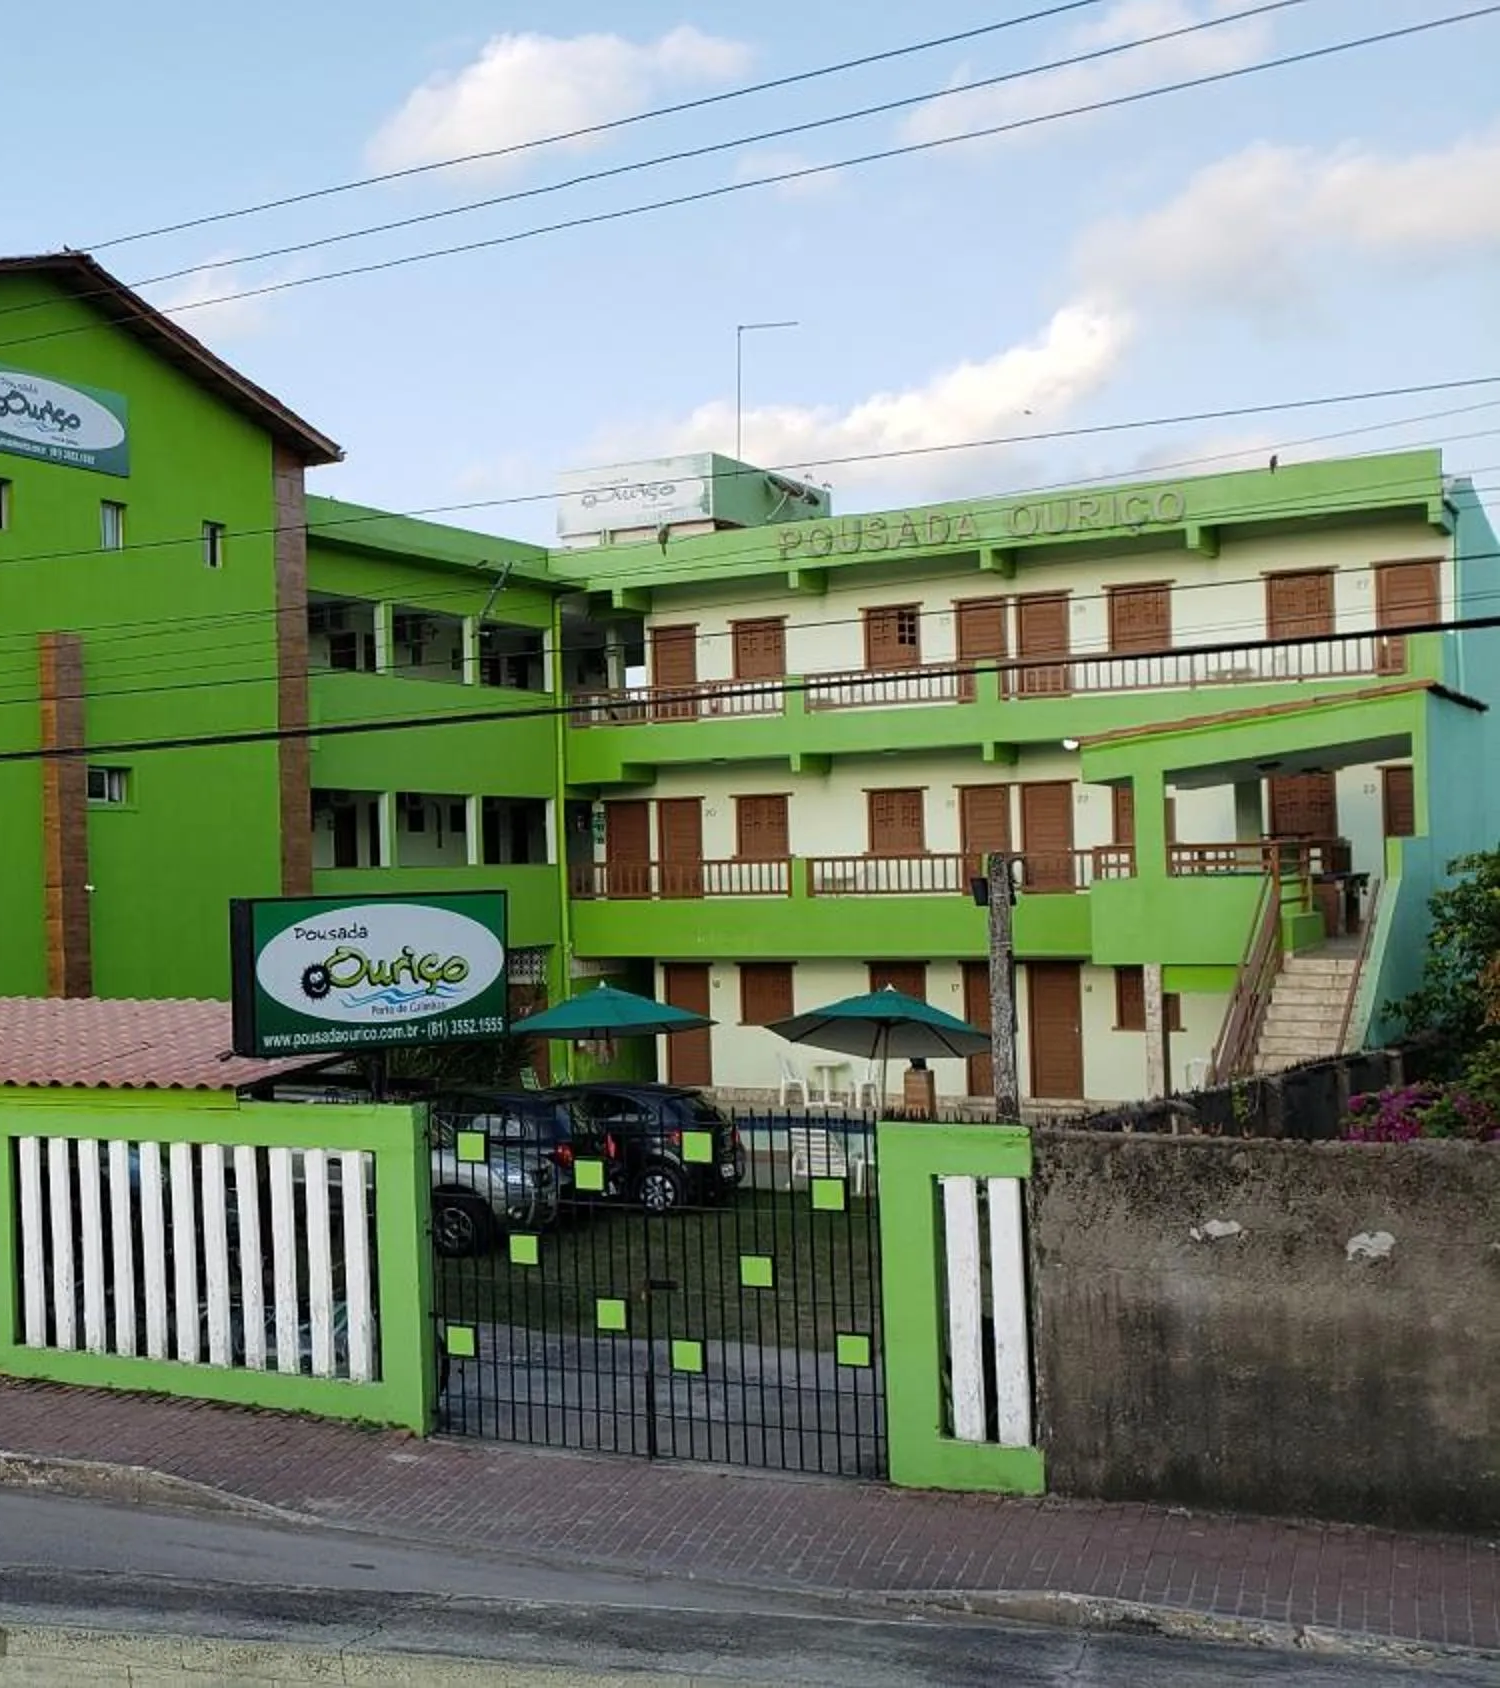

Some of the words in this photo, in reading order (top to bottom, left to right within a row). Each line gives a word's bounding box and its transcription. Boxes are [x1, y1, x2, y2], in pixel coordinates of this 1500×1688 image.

[778, 510, 979, 560] POUSADA
[1004, 490, 1188, 537] OURIÇO
[293, 922, 369, 941] Pousada
[323, 946, 470, 995] Ouriço
[263, 1024, 418, 1049] www.pousadaourico.com.br
[428, 1021, 449, 1040] (81)
[451, 1017, 504, 1036] 3552.1555
